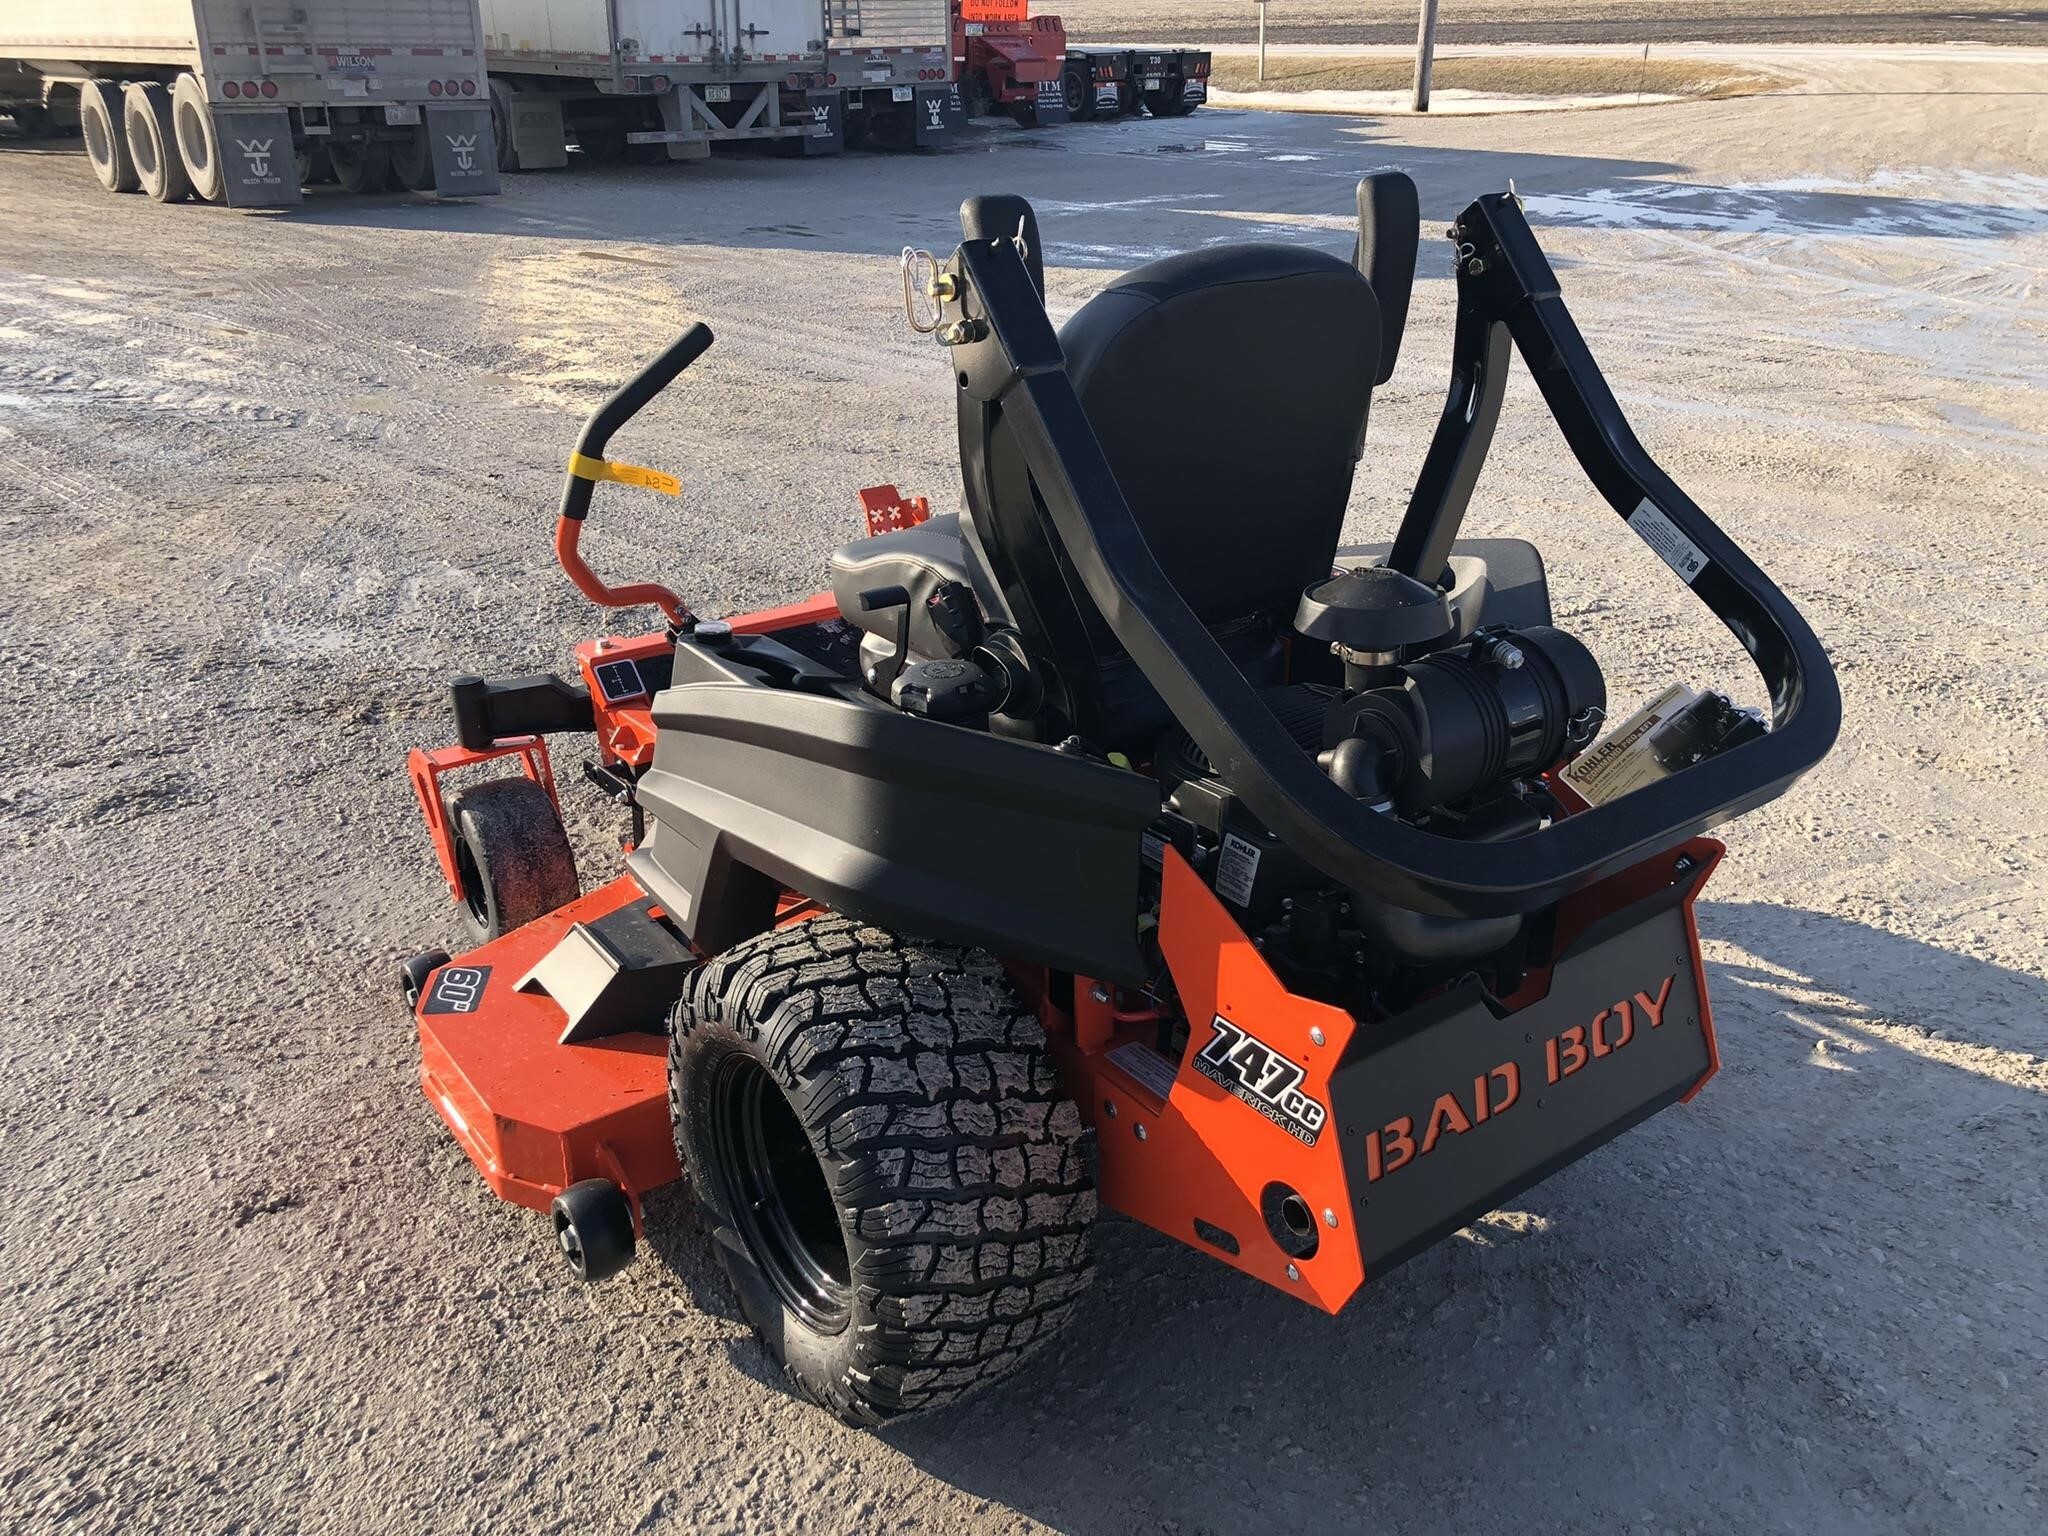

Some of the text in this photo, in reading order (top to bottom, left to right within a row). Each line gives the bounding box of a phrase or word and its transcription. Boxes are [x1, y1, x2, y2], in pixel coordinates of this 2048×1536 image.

[336, 56, 375, 67] WILSON
[1038, 80, 1061, 91] ITM
[1570, 741, 1617, 783] KOHLER
[1586, 720, 1653, 783] COMMAND PRO EFI
[1230, 838, 1256, 858] KOHLER
[1365, 974, 1677, 1184] BAD BOY
[1193, 1057, 1286, 1129] MAVERICK
[1287, 1120, 1316, 1147] HD
